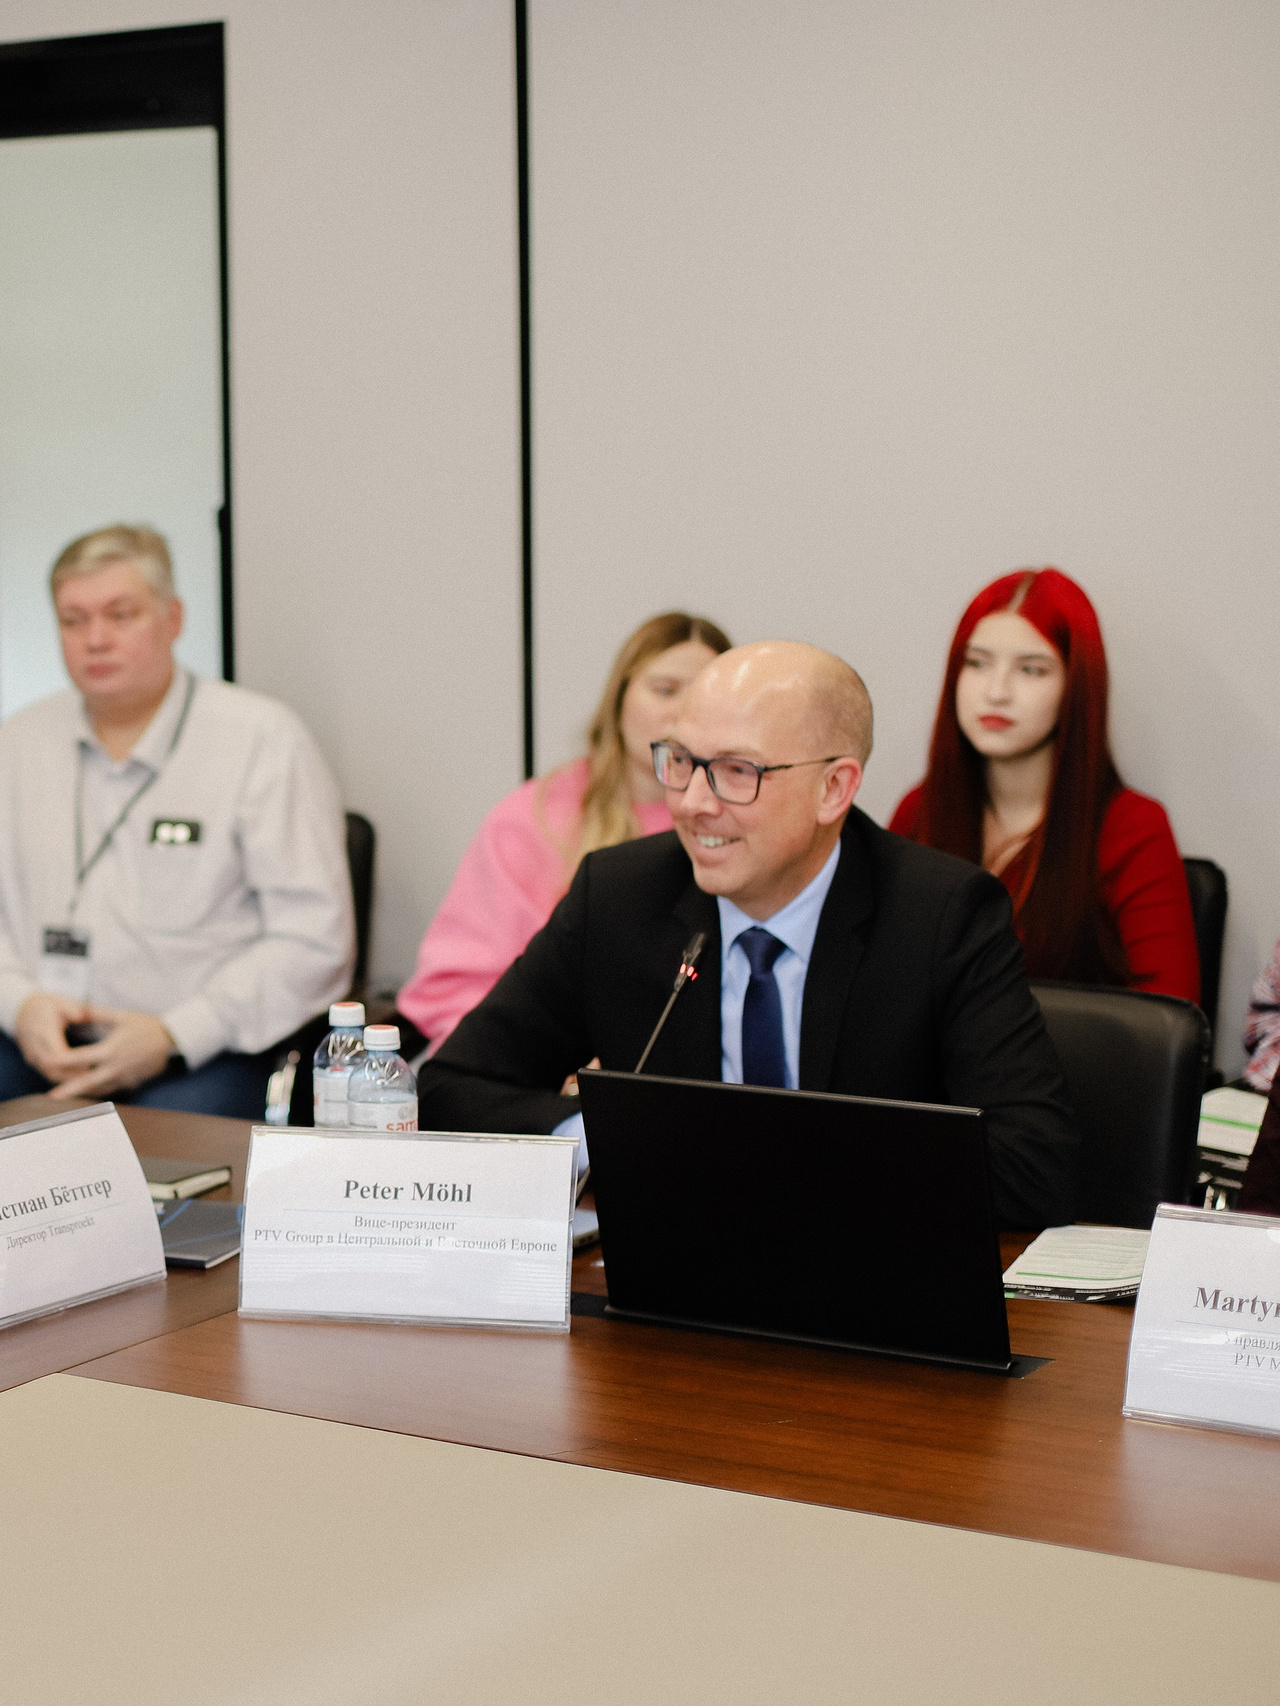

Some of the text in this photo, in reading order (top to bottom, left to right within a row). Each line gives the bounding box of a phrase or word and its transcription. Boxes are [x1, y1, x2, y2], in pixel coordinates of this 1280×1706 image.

[50, 1179, 113, 1207] Бёттгер
[344, 1179, 473, 1203] Peter Möhl
[6, 1215, 96, 1250] Директор Transproekt
[354, 1215, 456, 1231] Вице-президент
[254, 1229, 282, 1241] PTV
[286, 1230, 323, 1245] Group
[326, 1236, 334, 1244] в
[337, 1232, 422, 1248] Центральной
[425, 1238, 433, 1247] и
[510, 1238, 557, 1254] Европе
[1234, 1352, 1266, 1367] PTV
